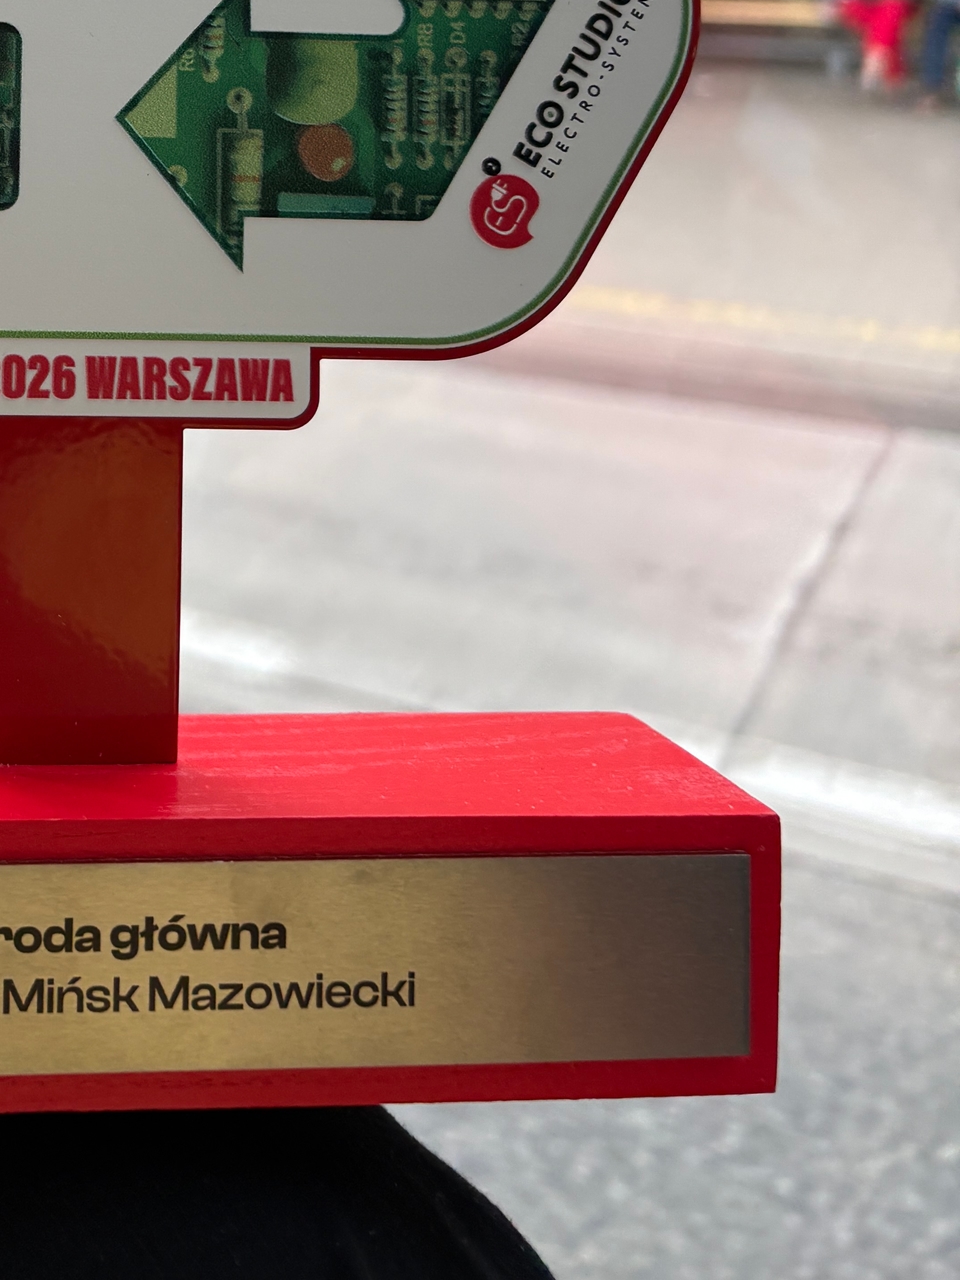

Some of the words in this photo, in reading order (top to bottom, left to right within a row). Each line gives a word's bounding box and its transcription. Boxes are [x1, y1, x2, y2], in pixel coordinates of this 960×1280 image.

[513, 100, 564, 168] ECO
[85, 355, 295, 402] WARSZAWA
[109, 914, 287, 960] główna
[3, 976, 140, 1014] Mińsk
[148, 972, 415, 1012] Mazowiecki
